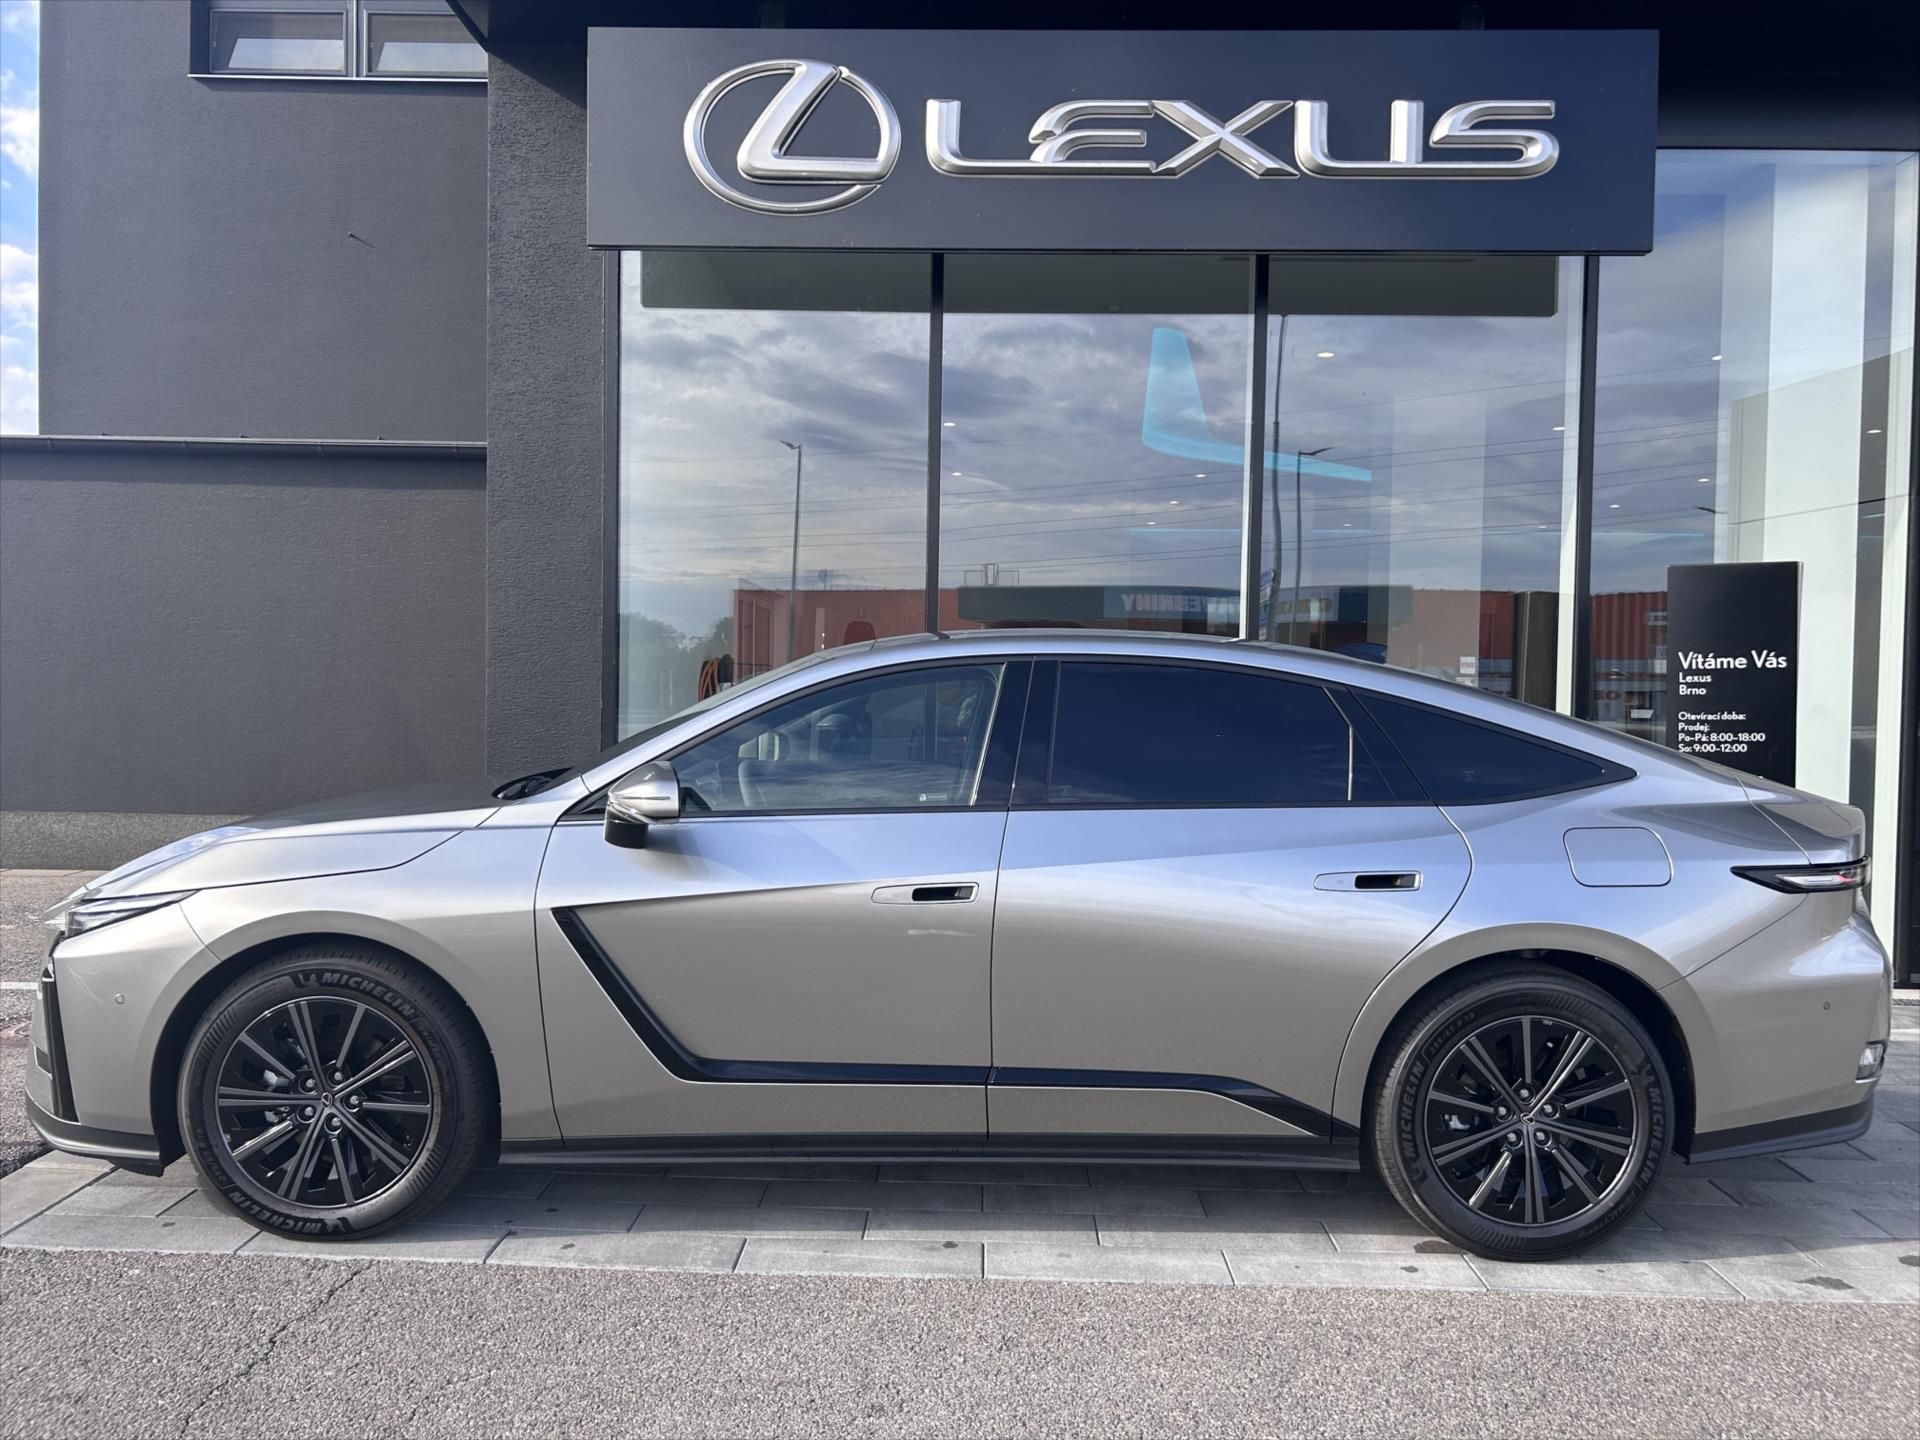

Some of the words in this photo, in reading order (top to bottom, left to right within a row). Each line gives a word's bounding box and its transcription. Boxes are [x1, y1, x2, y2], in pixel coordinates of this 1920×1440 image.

[925, 99, 1560, 180] LEXUS
[1678, 652, 1748, 669] Vítáme
[1751, 650, 1788, 668] Vás
[1679, 672, 1712, 683] Lexus
[1679, 684, 1707, 695] Brno
[1678, 711, 1721, 720] Otevírací
[1721, 711, 1747, 720] doba:
[1678, 722, 1710, 733] Prodej:
[1678, 743, 1692, 753] So:
[322, 971, 418, 1023] MICHELIN
[1400, 1060, 1425, 1159] MICHELIN
[1640, 1086, 1666, 1184] MICHELIN
[228, 1190, 323, 1235] MICHELIN
